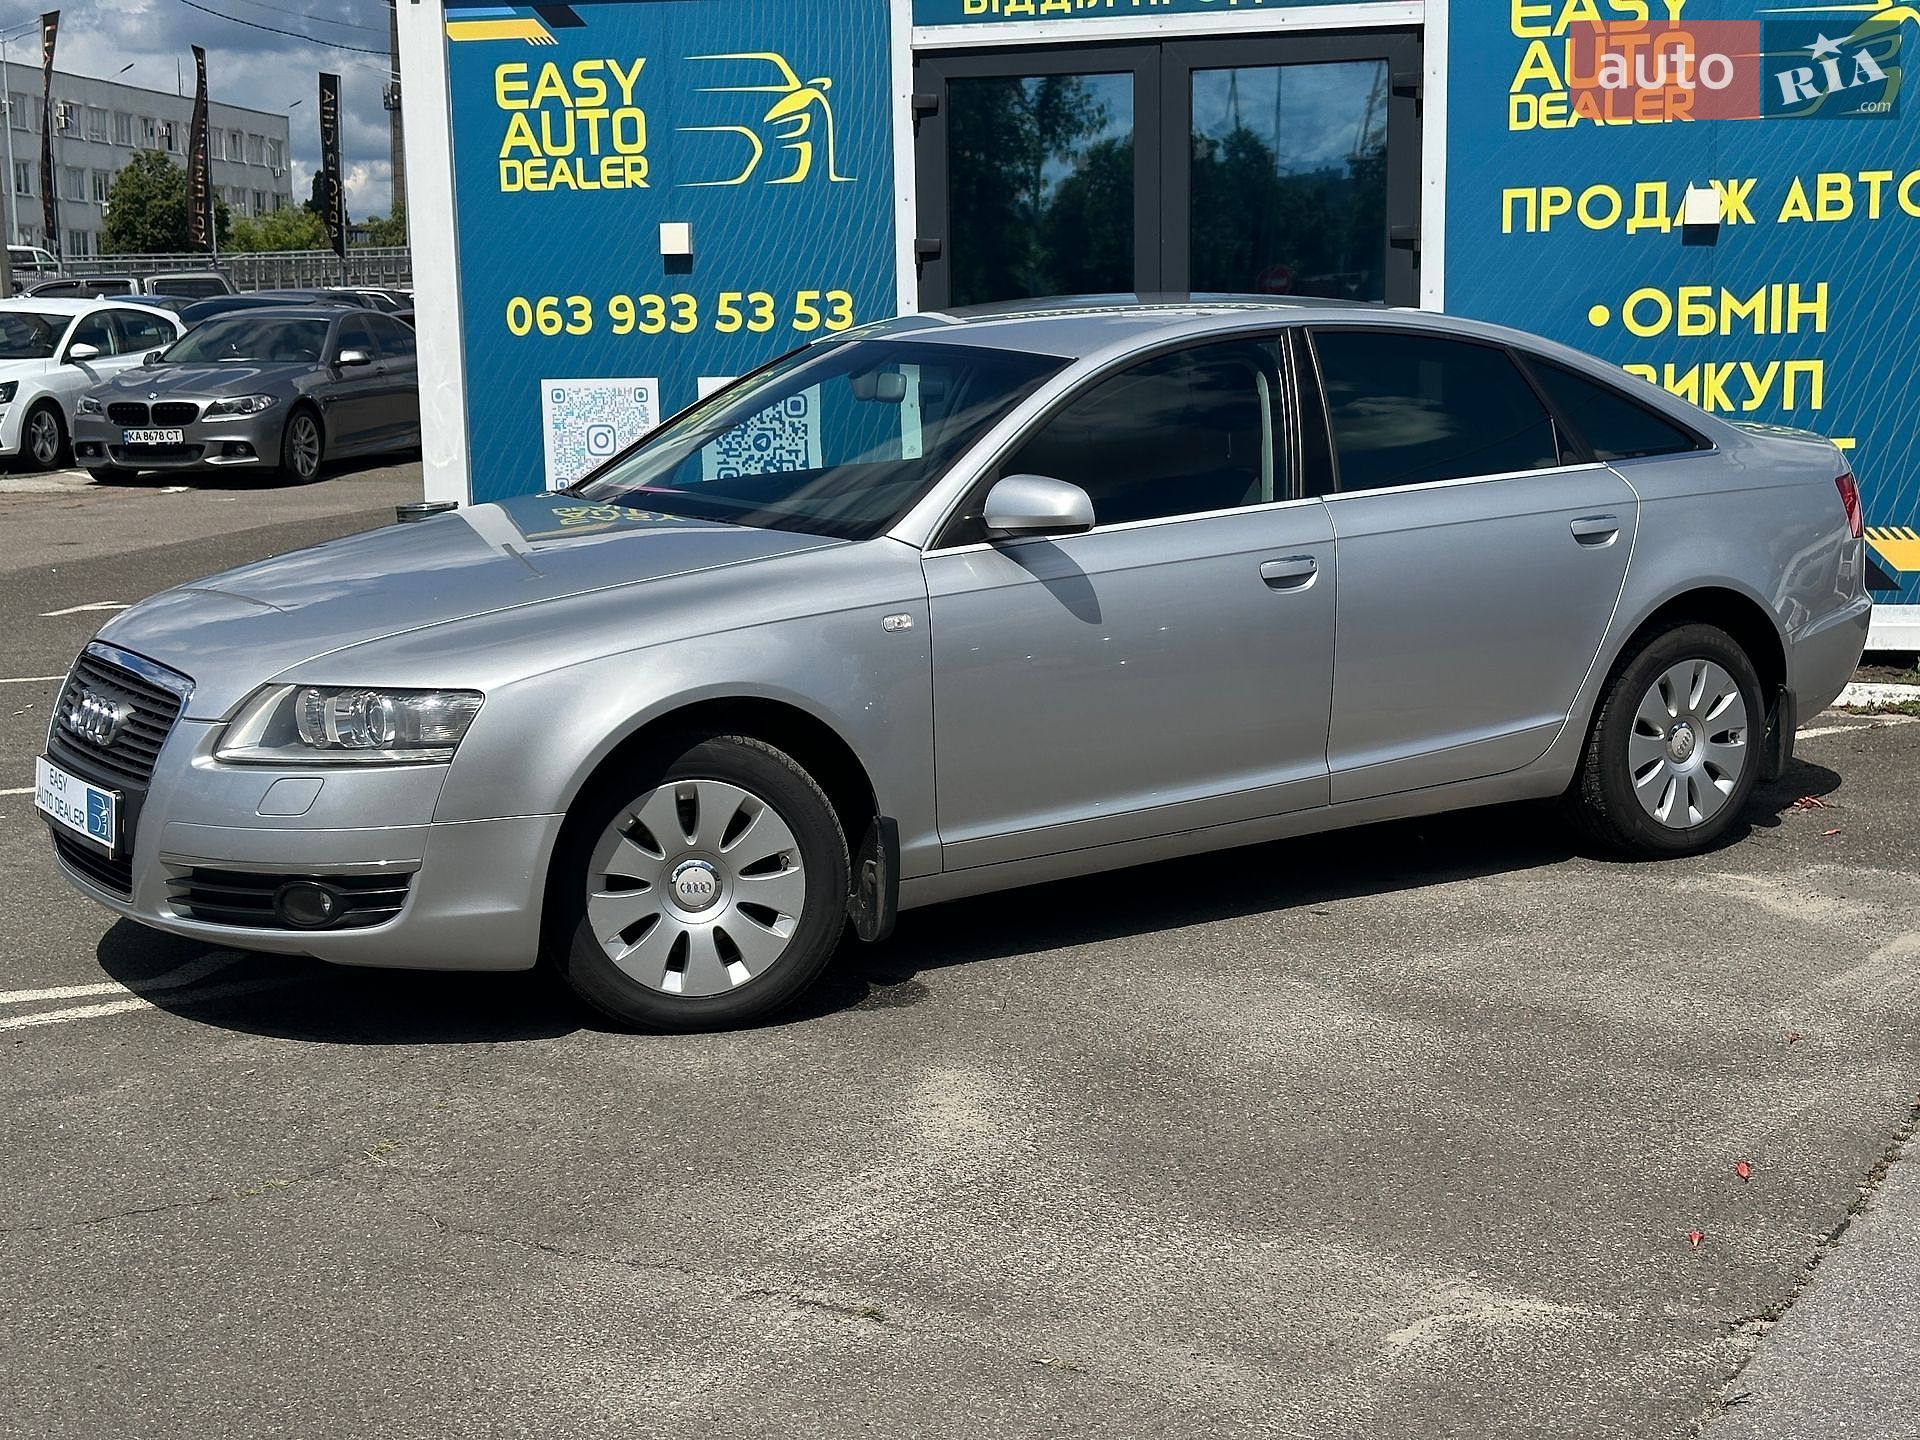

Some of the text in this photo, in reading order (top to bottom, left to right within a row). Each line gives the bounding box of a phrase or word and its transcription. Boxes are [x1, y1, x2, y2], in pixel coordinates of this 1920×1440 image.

[1510, 0, 1688, 38] EASY
[495, 57, 646, 109] EASY
[1509, 31, 1696, 92] AUTO
[1509, 84, 1696, 131] DEALER
[499, 107, 647, 158] AUTO
[499, 155, 651, 192] DEALER
[506, 290, 853, 336] 063 933 53 53
[1622, 282, 1828, 337] ОБМІН
[128, 430, 180, 441] KA 8678 CT
[49, 768, 68, 793] EASY
[37, 785, 85, 829] AUTO DEALER
